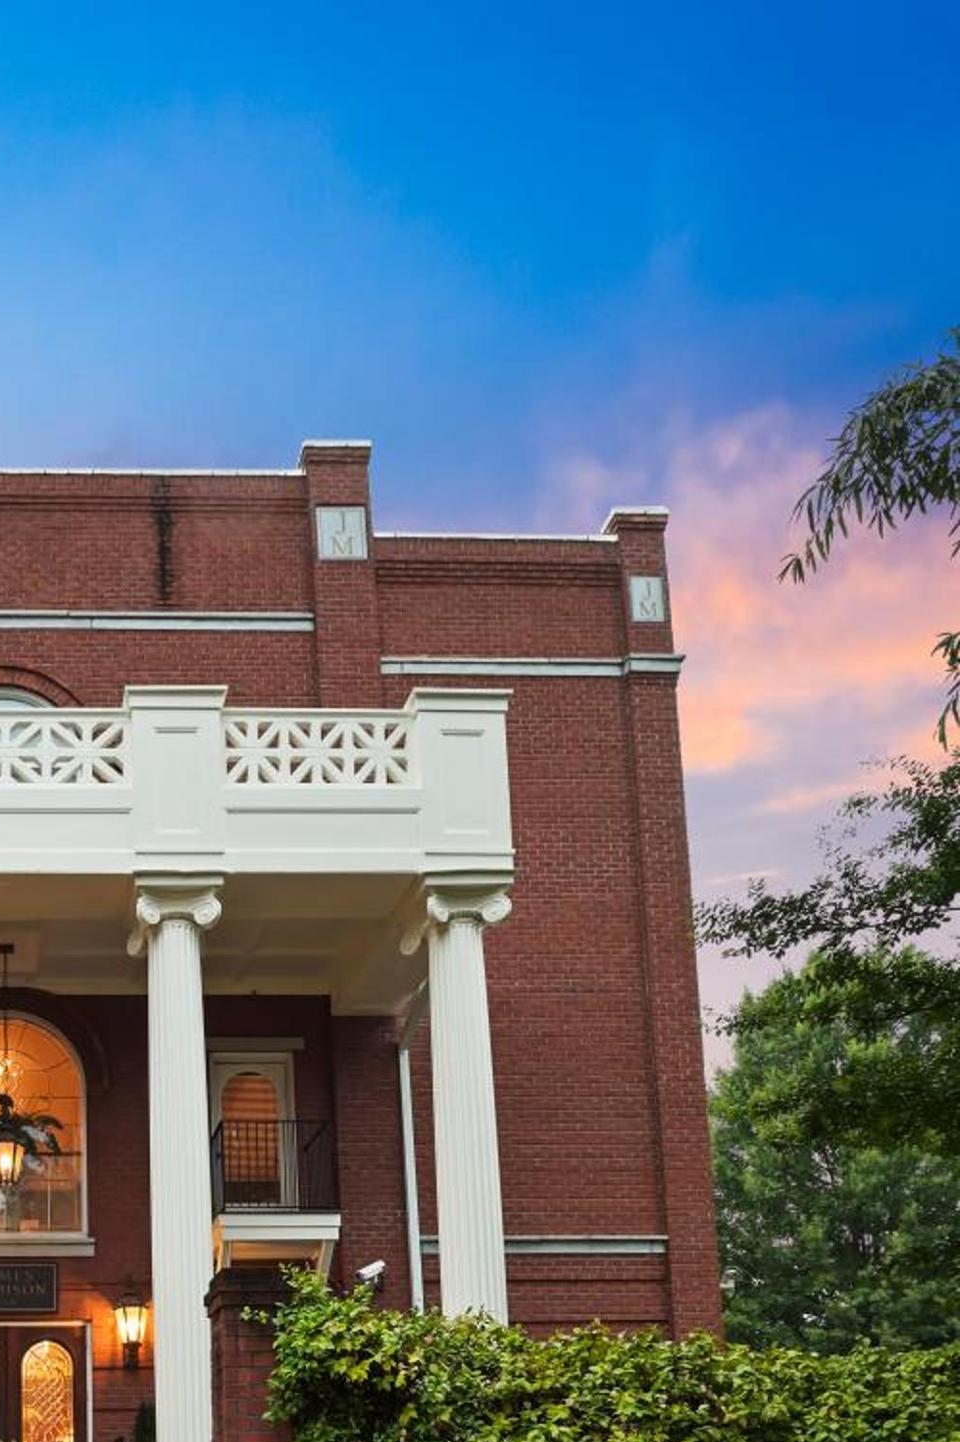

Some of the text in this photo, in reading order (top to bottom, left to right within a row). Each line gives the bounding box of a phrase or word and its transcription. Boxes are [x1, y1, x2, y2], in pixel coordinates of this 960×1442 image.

[335, 510, 346, 535] J
[331, 535, 354, 555] M
[640, 601, 657, 617] M
